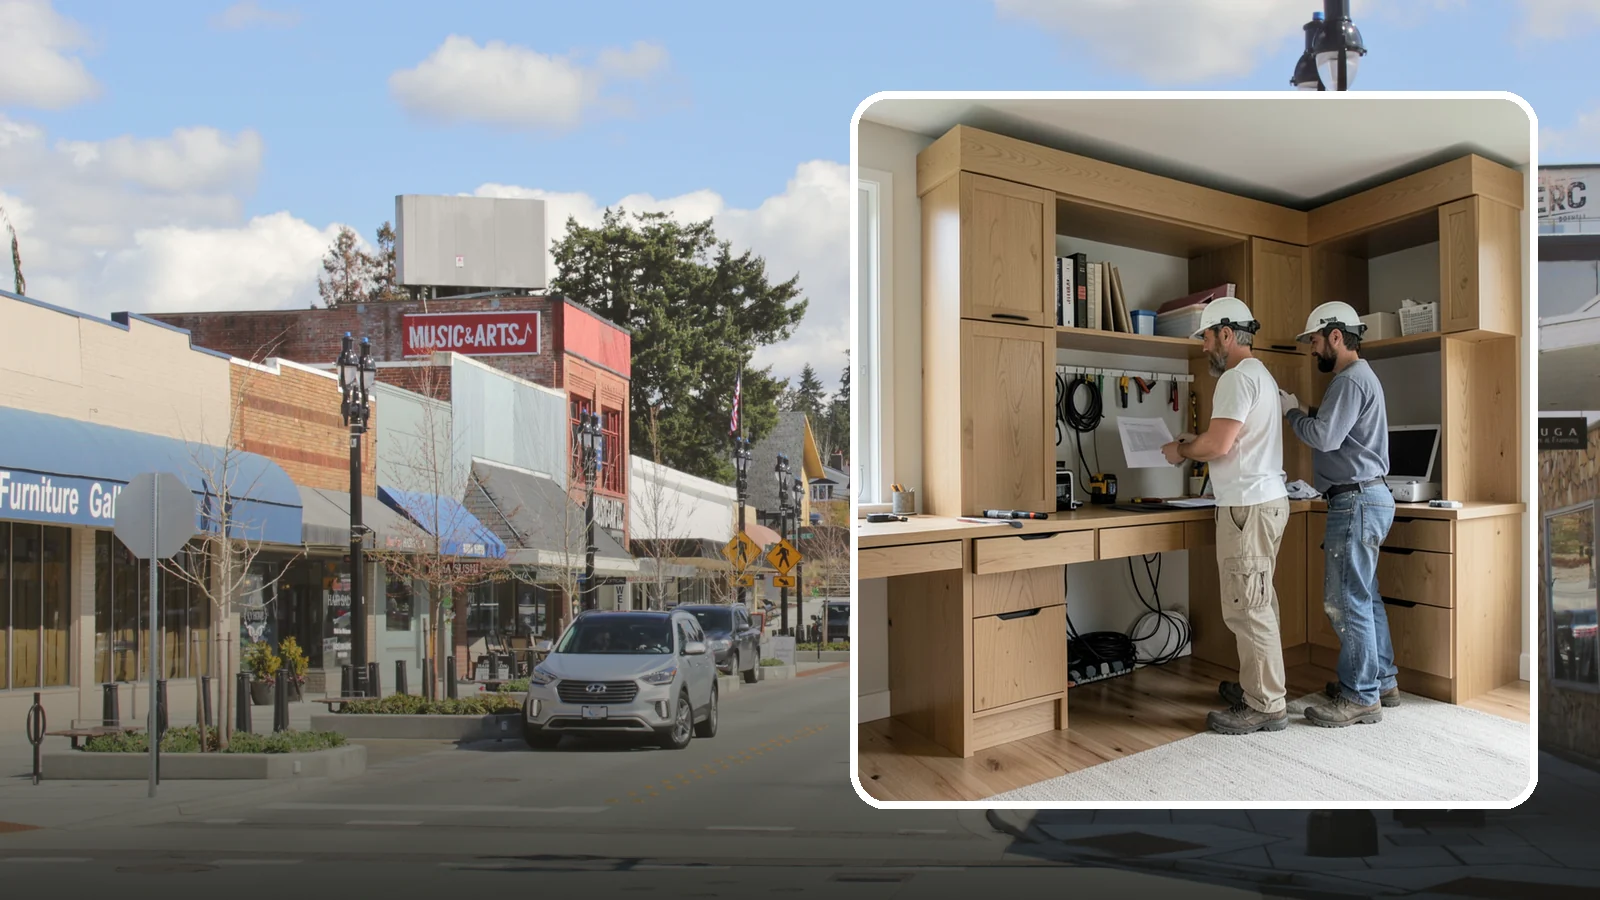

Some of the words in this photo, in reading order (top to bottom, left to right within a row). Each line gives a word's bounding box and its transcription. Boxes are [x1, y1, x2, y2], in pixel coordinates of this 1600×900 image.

[1540, 428, 1577, 436] UGA
[0, 471, 79, 515] Furniture
[90, 482, 122, 519] Gal
[453, 563, 479, 574] SUSHI
